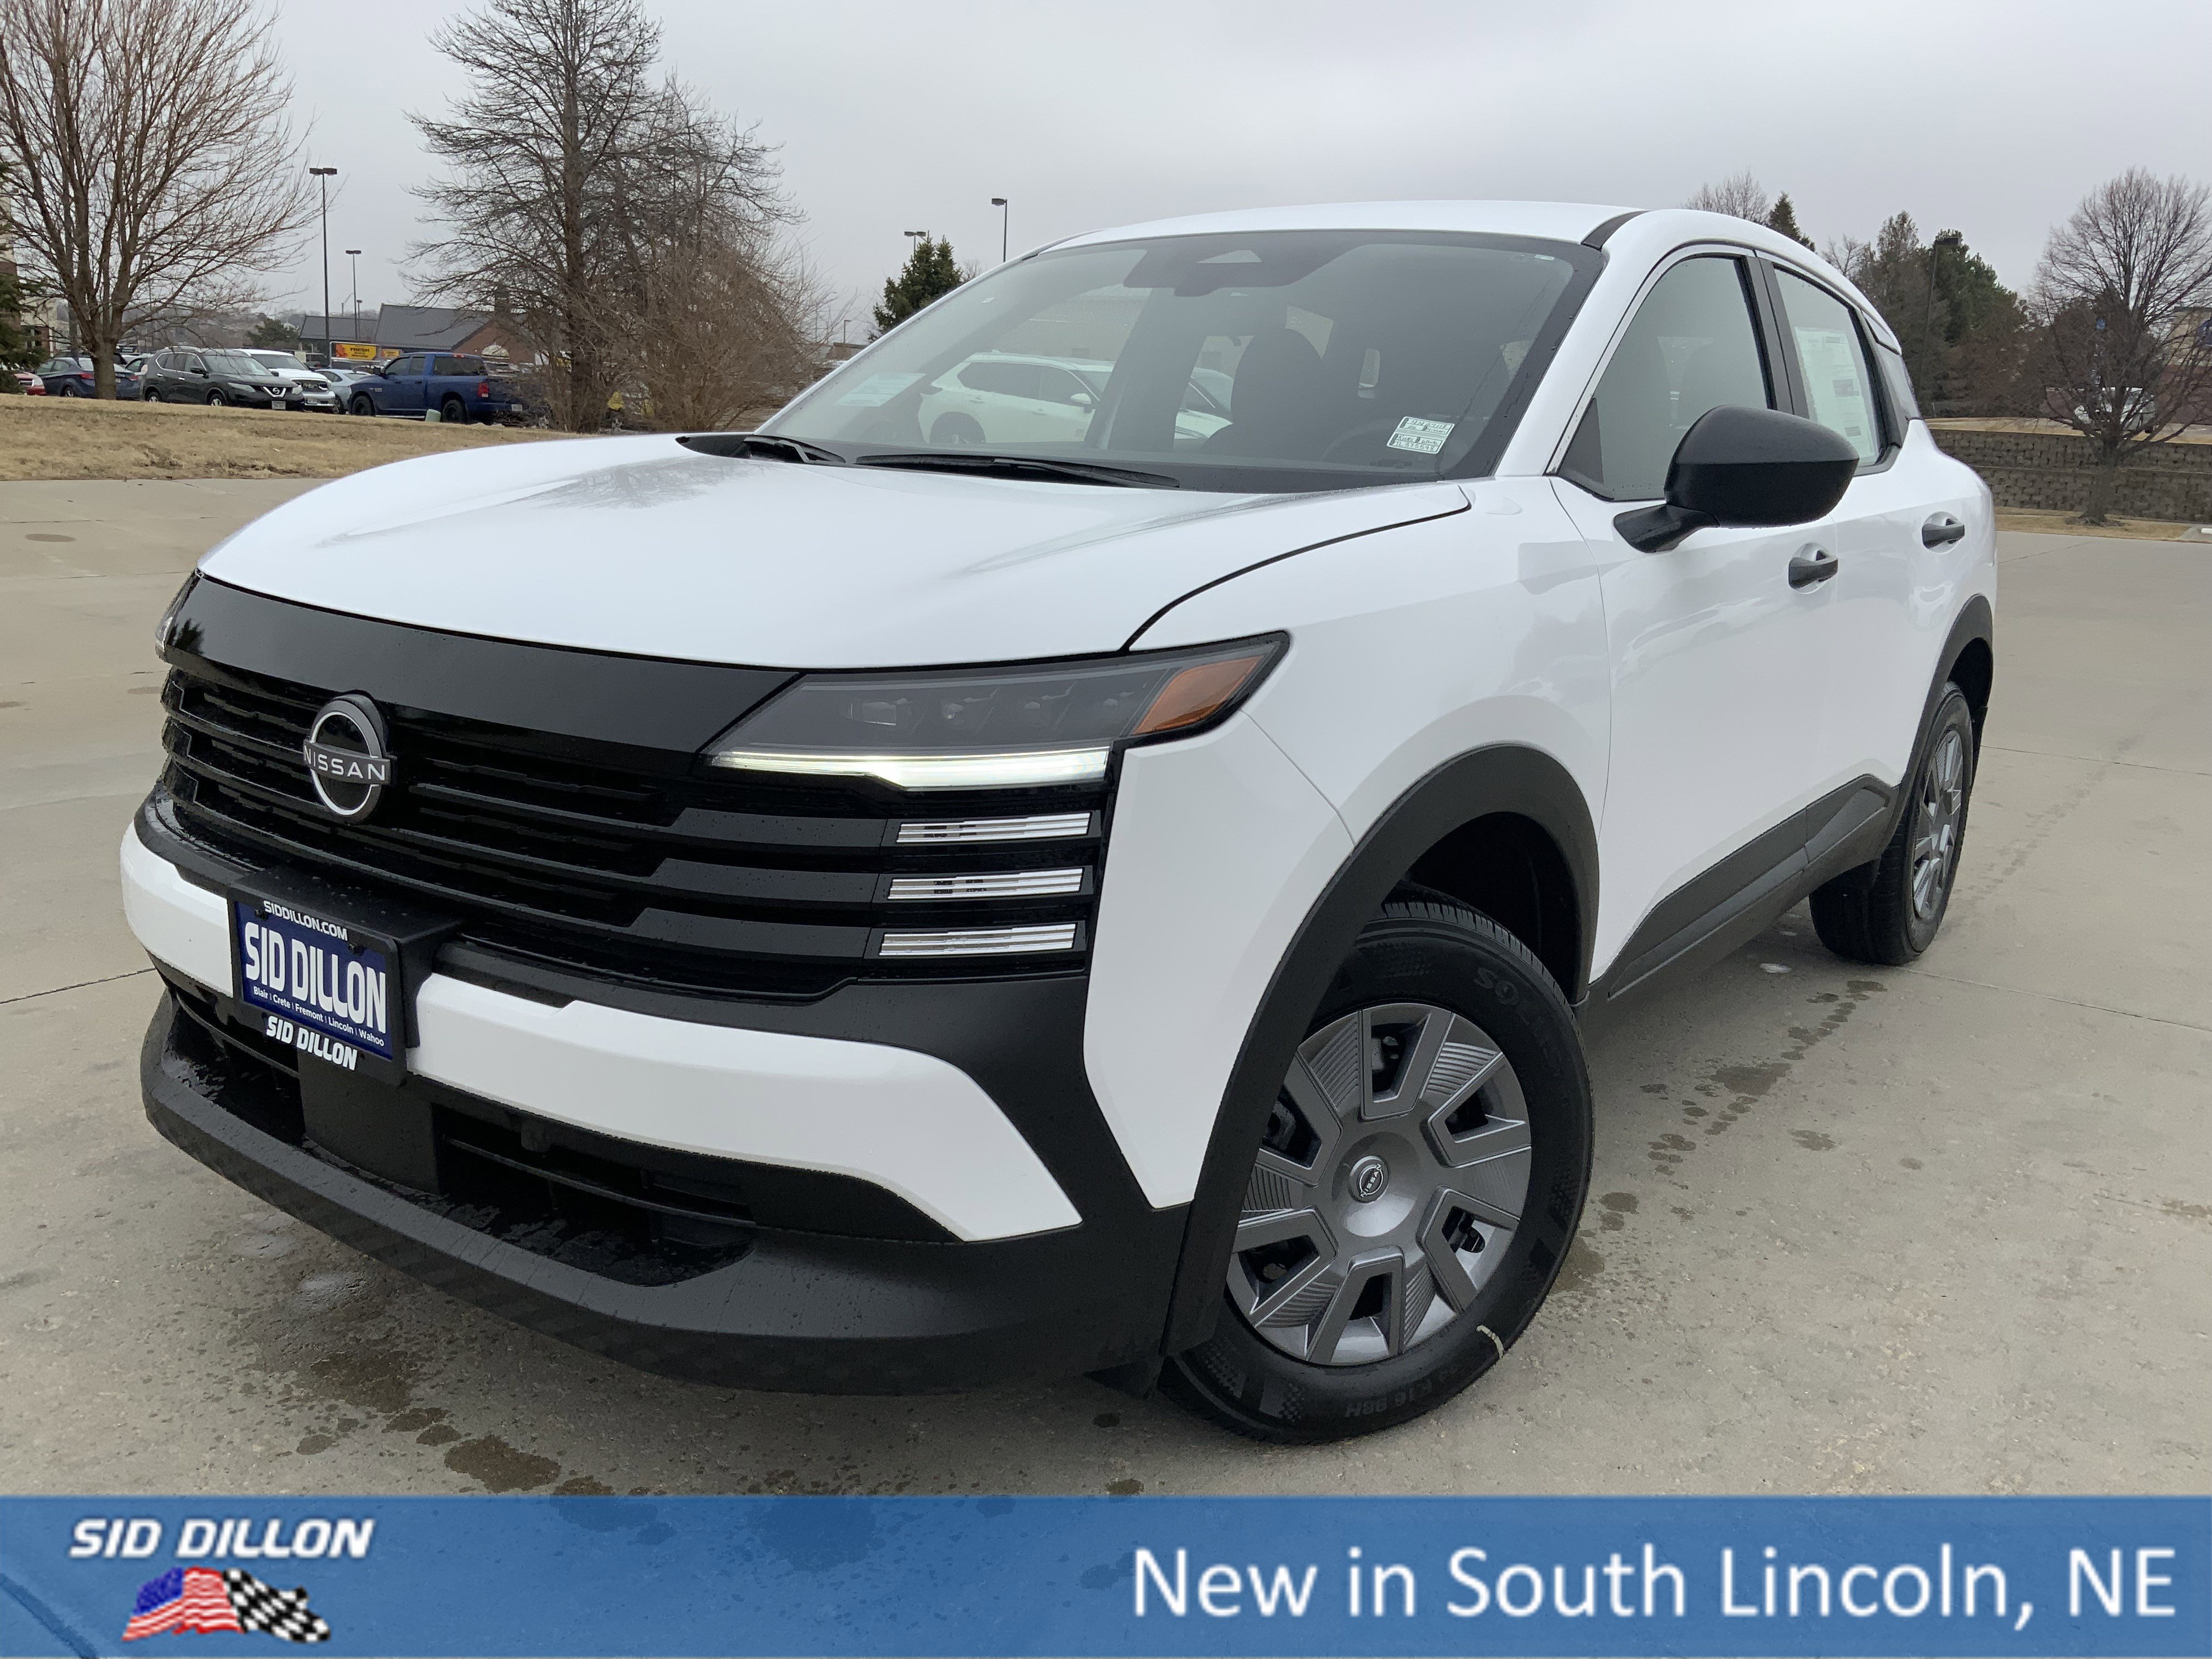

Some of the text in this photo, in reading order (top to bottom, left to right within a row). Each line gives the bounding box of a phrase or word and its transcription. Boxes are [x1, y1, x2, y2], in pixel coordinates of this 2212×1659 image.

[303, 745, 385, 781] NISSAN
[263, 900, 348, 941] SIDDILLON.COM
[245, 922, 386, 1034] SID DILLON
[253, 986, 385, 1047] Blair Crete Fremont Lincoln Wahoo
[266, 1015, 358, 1071] SID DILLON
